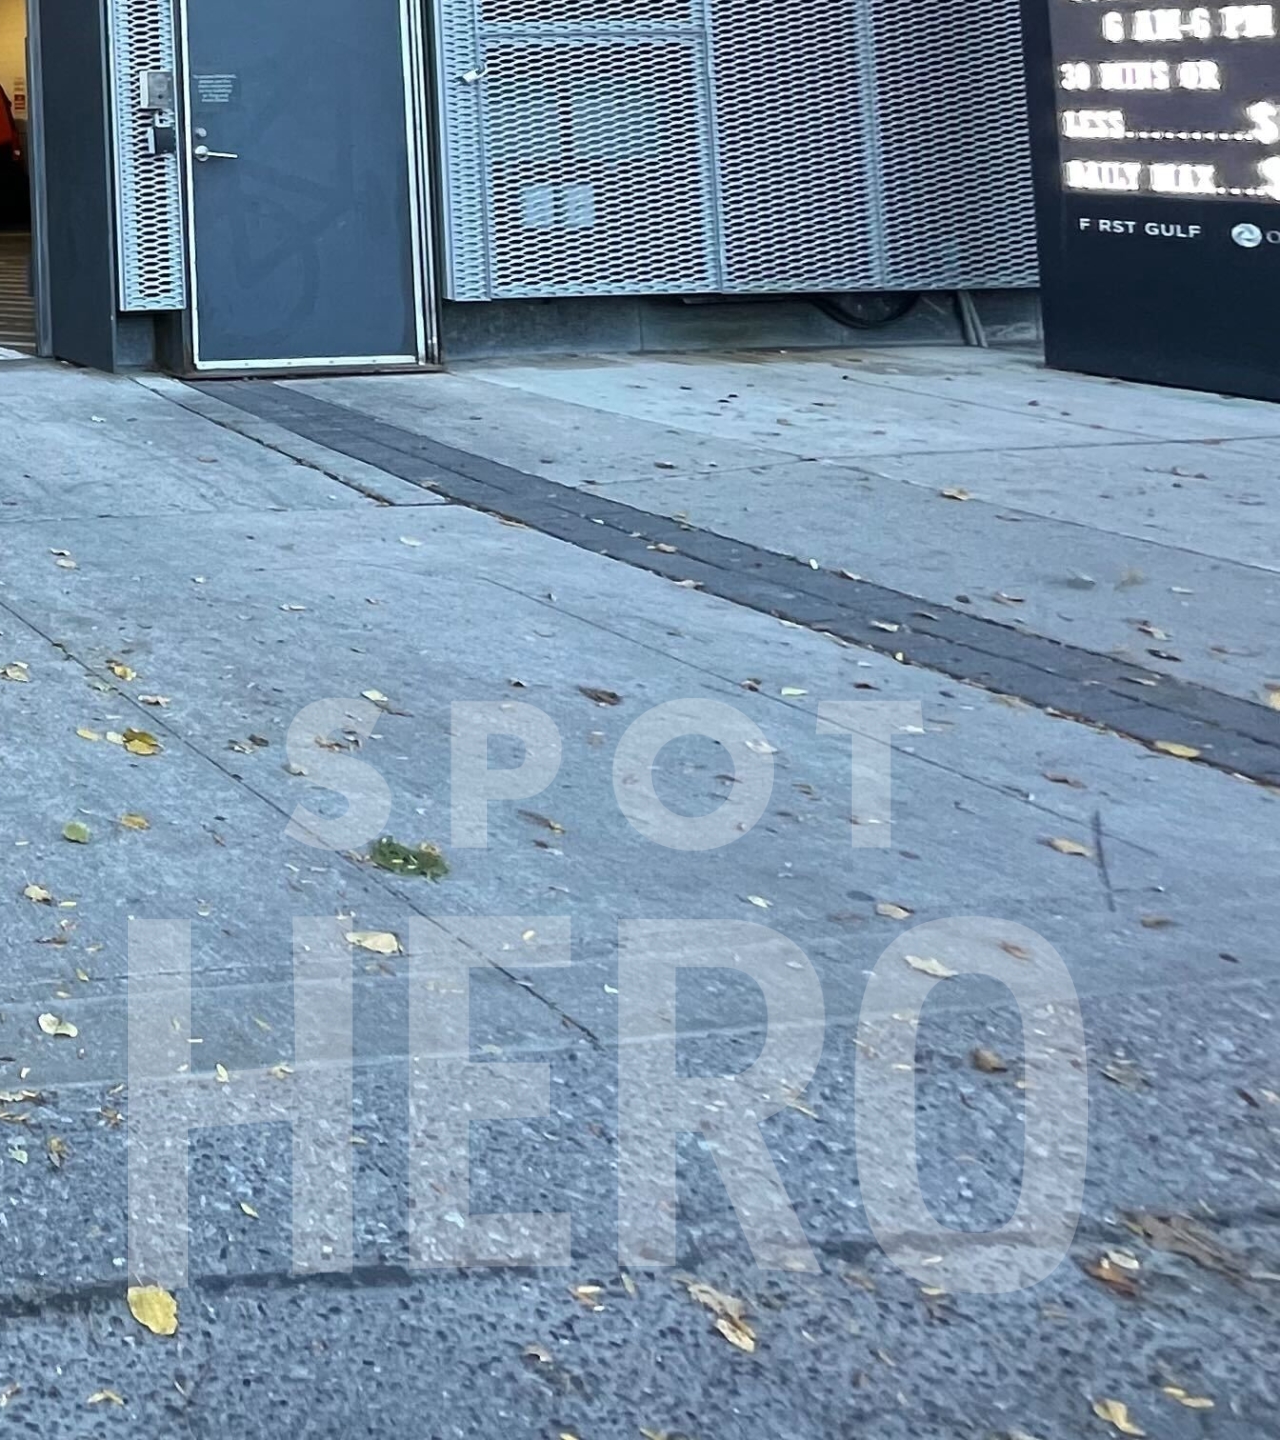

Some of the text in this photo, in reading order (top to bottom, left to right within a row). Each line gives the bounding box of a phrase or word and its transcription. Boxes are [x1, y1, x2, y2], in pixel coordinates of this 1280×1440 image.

[1102, 11, 1125, 42] 6
[1219, 4, 1276, 39] PM
[1060, 61, 1091, 91] 30
[1177, 60, 1222, 90] OR
[1079, 218, 1202, 239] FRST GULF
